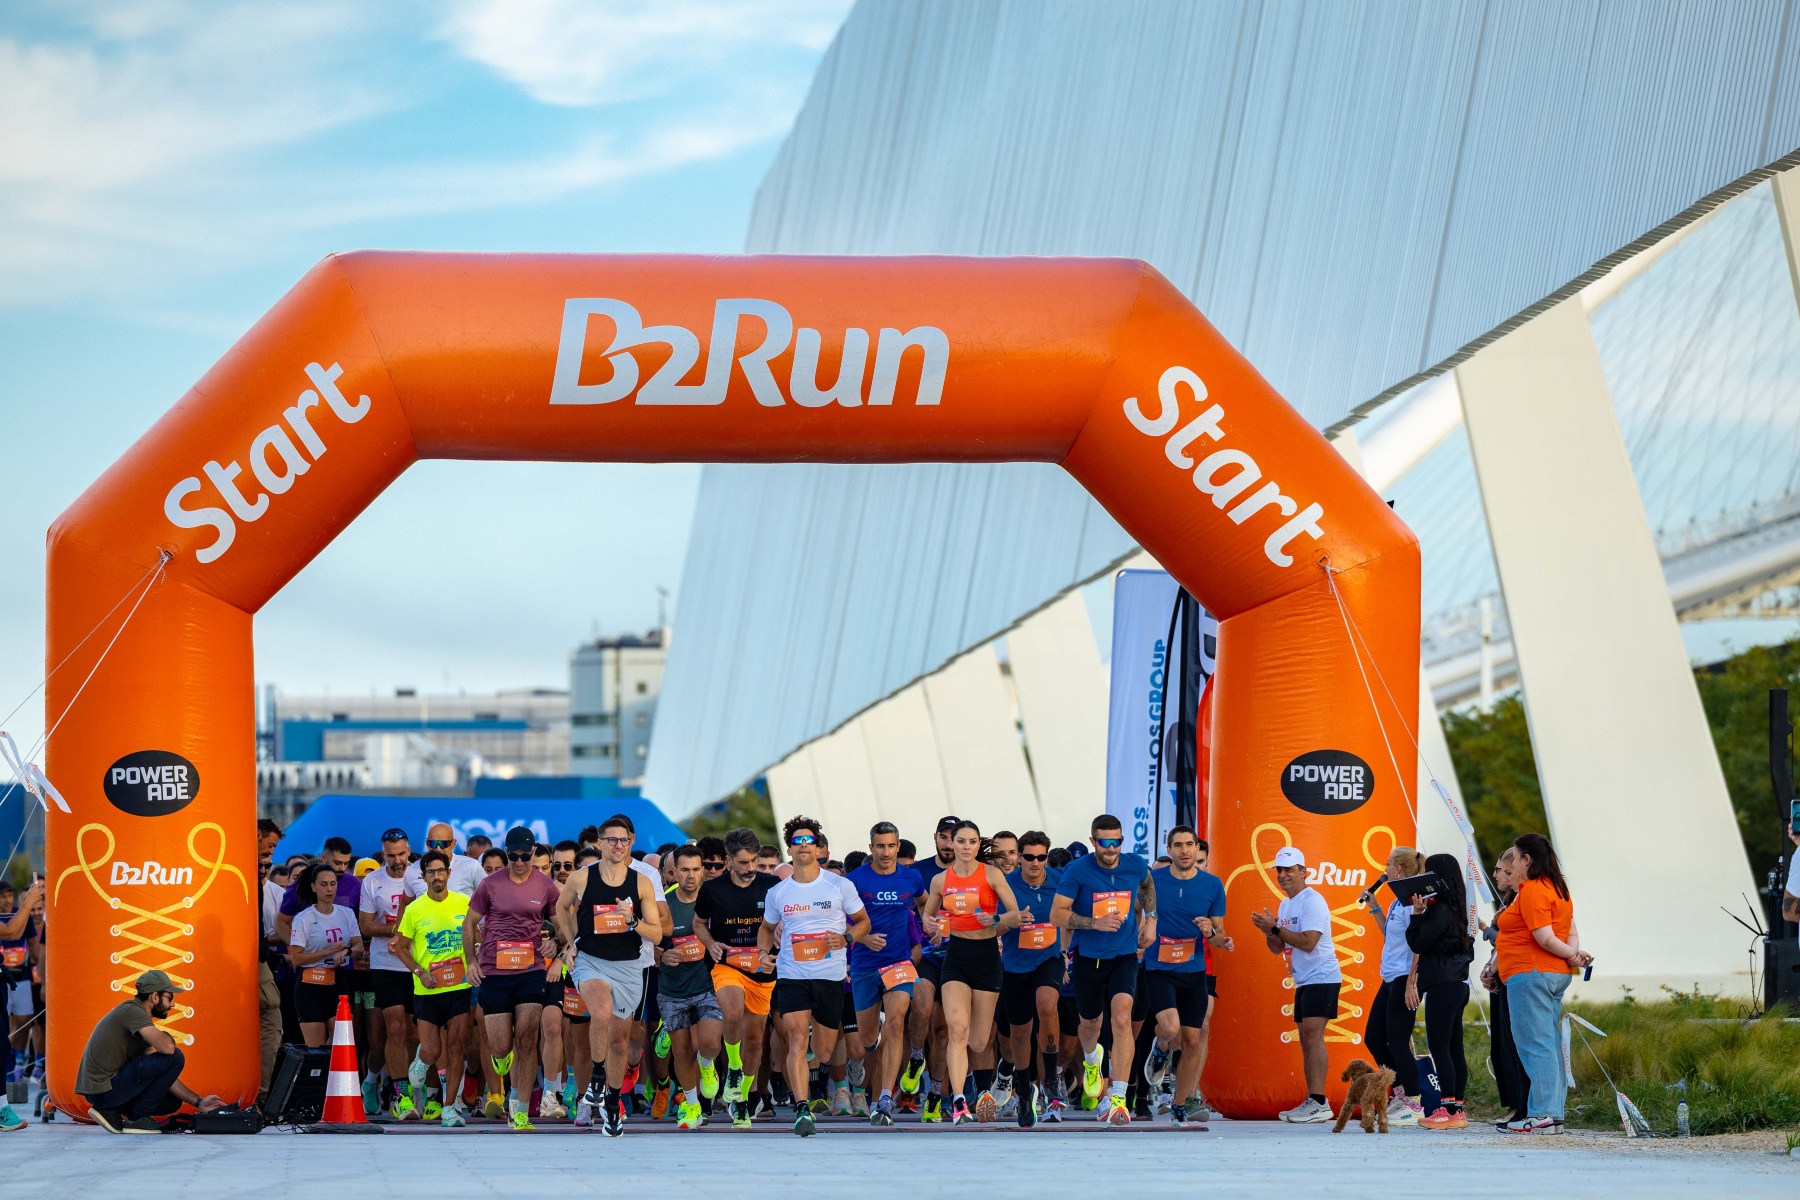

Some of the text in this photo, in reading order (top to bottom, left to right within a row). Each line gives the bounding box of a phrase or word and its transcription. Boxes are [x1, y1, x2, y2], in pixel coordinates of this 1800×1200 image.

[549, 297, 950, 409] B2Run
[163, 361, 372, 564] Start
[1122, 365, 1325, 568] Start
[112, 765, 188, 786] POWER
[1289, 764, 1364, 785] POWER
[147, 783, 190, 802] ADE
[1324, 782, 1366, 801] ADE
[110, 861, 193, 886] B2Run
[1305, 861, 1367, 886] 2Run
[877, 891, 898, 901] CGS
[724, 917, 737, 925] Jet
[736, 926, 751, 935] and
[737, 916, 764, 925] lagged
[1469, 903, 1477, 937] #Run2P
[803, 947, 819, 955] 1697
